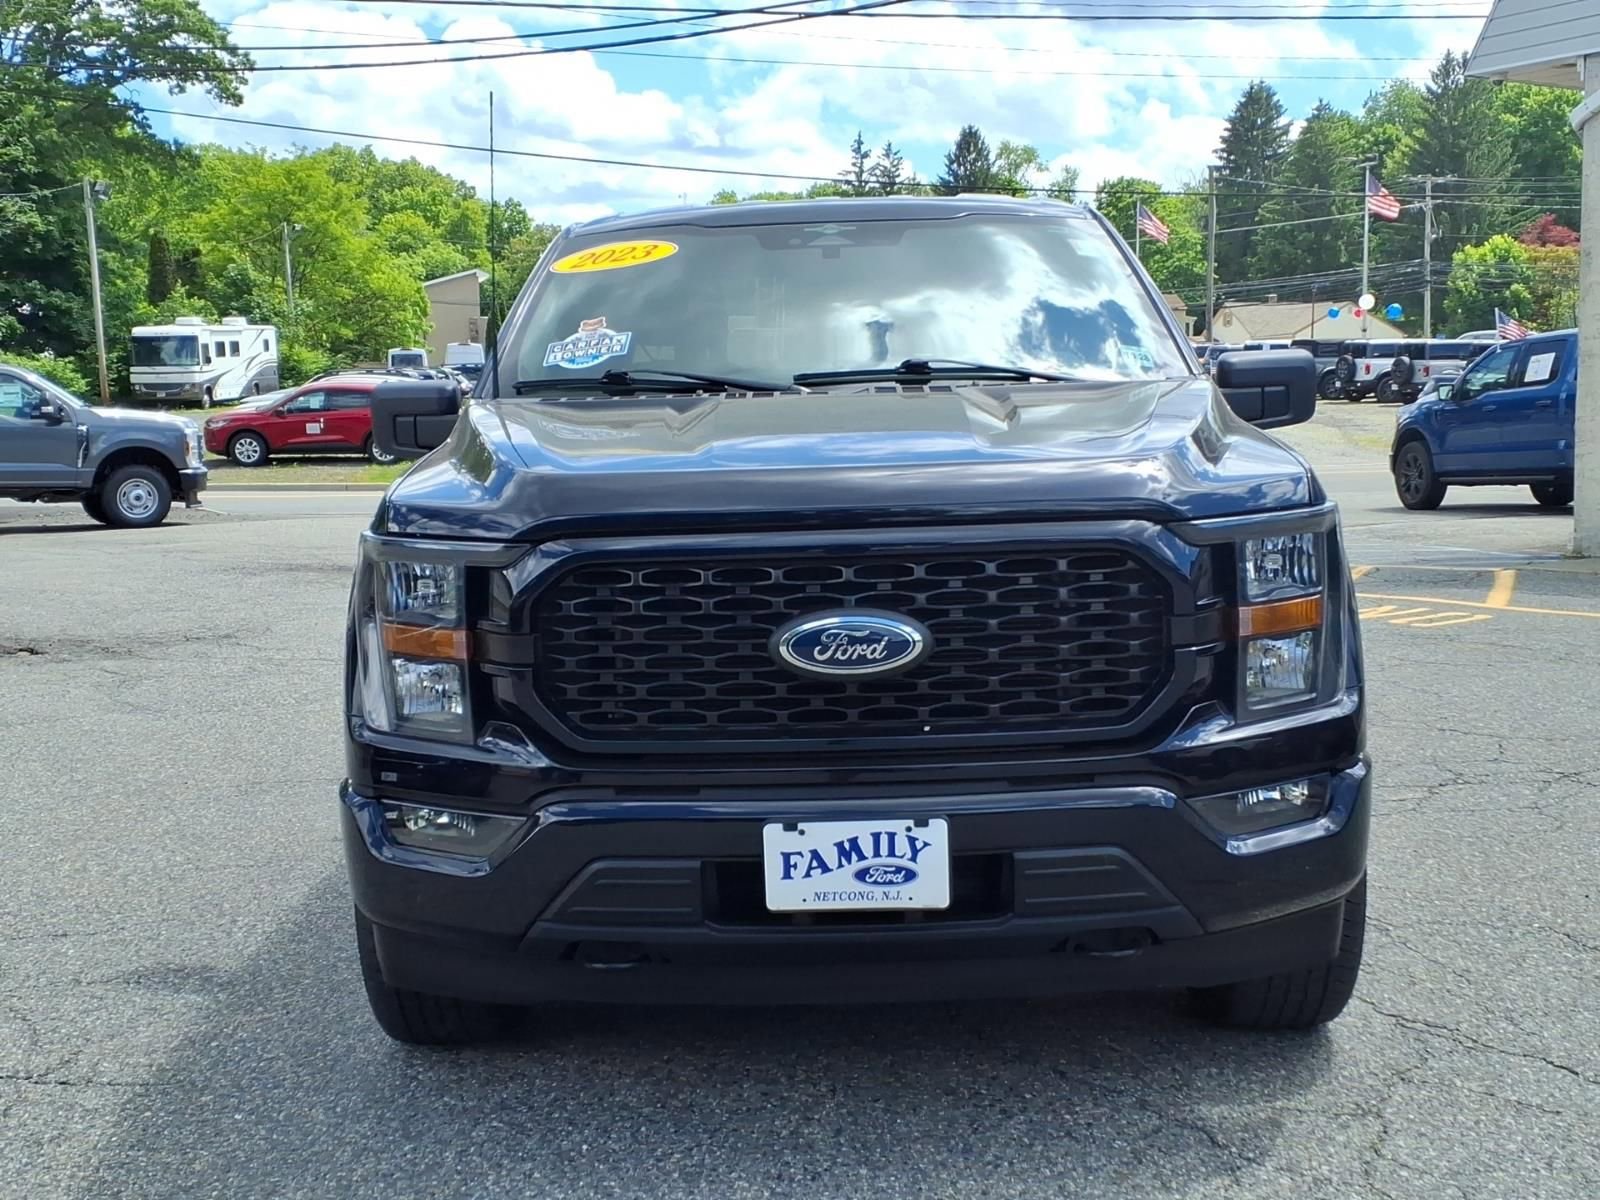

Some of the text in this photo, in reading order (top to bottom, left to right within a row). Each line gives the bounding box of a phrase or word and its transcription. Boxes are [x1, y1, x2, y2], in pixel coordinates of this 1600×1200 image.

[570, 244, 659, 269] 2023
[552, 336, 625, 353] CARFAX
[813, 629, 889, 661] Ford
[779, 831, 932, 881] FAMILY
[865, 866, 906, 883] Ford
[812, 890, 903, 902] NETCONG, N.J.
